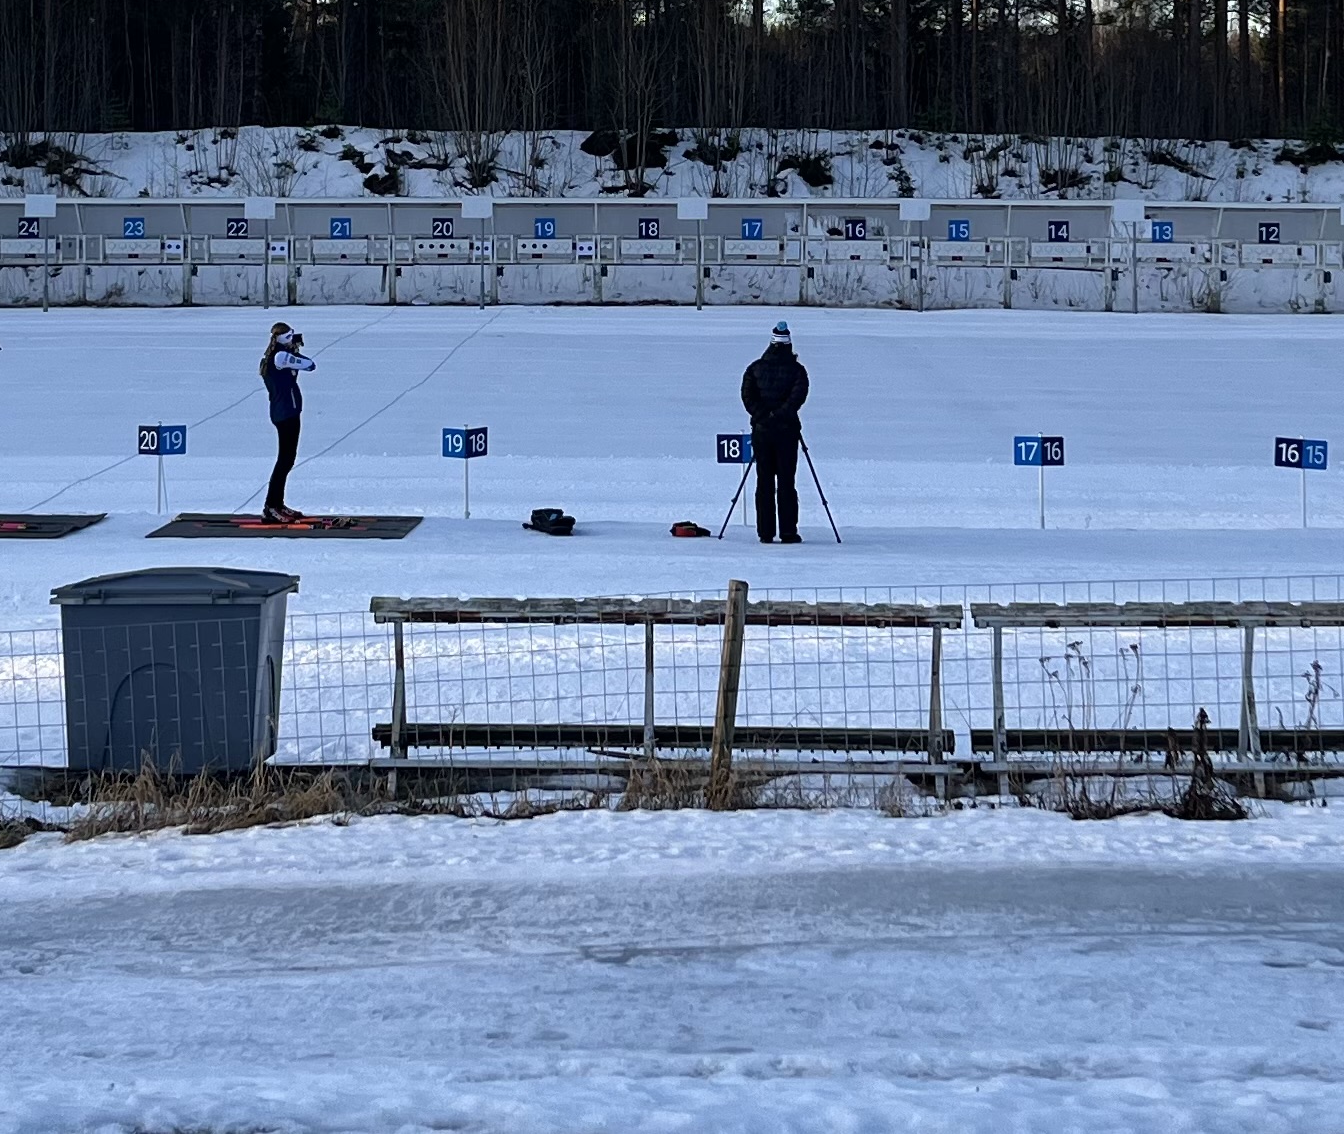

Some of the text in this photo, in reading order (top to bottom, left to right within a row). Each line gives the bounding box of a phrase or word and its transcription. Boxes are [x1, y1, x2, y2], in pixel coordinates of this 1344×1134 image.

[19, 221, 39, 236] 24
[124, 221, 144, 236] 23
[228, 222, 248, 237] 22
[332, 221, 350, 236] 21
[433, 221, 453, 236] 20
[535, 222, 554, 236] 19
[639, 222, 658, 236] 18
[742, 222, 762, 237] 17
[845, 223, 865, 237] 16
[949, 223, 968, 238] 15
[1048, 224, 1068, 239] 14
[1153, 225, 1172, 240] 13
[1259, 226, 1279, 241] 12
[139, 430, 158, 450] 20
[162, 430, 183, 450] 19
[444, 434, 463, 453] 19
[469, 432, 486, 453] 18
[719, 439, 740, 458] 18
[1017, 441, 1038, 461] 17
[1043, 441, 1061, 461] 16
[1278, 442, 1299, 463] 16
[1306, 445, 1325, 465] 15
